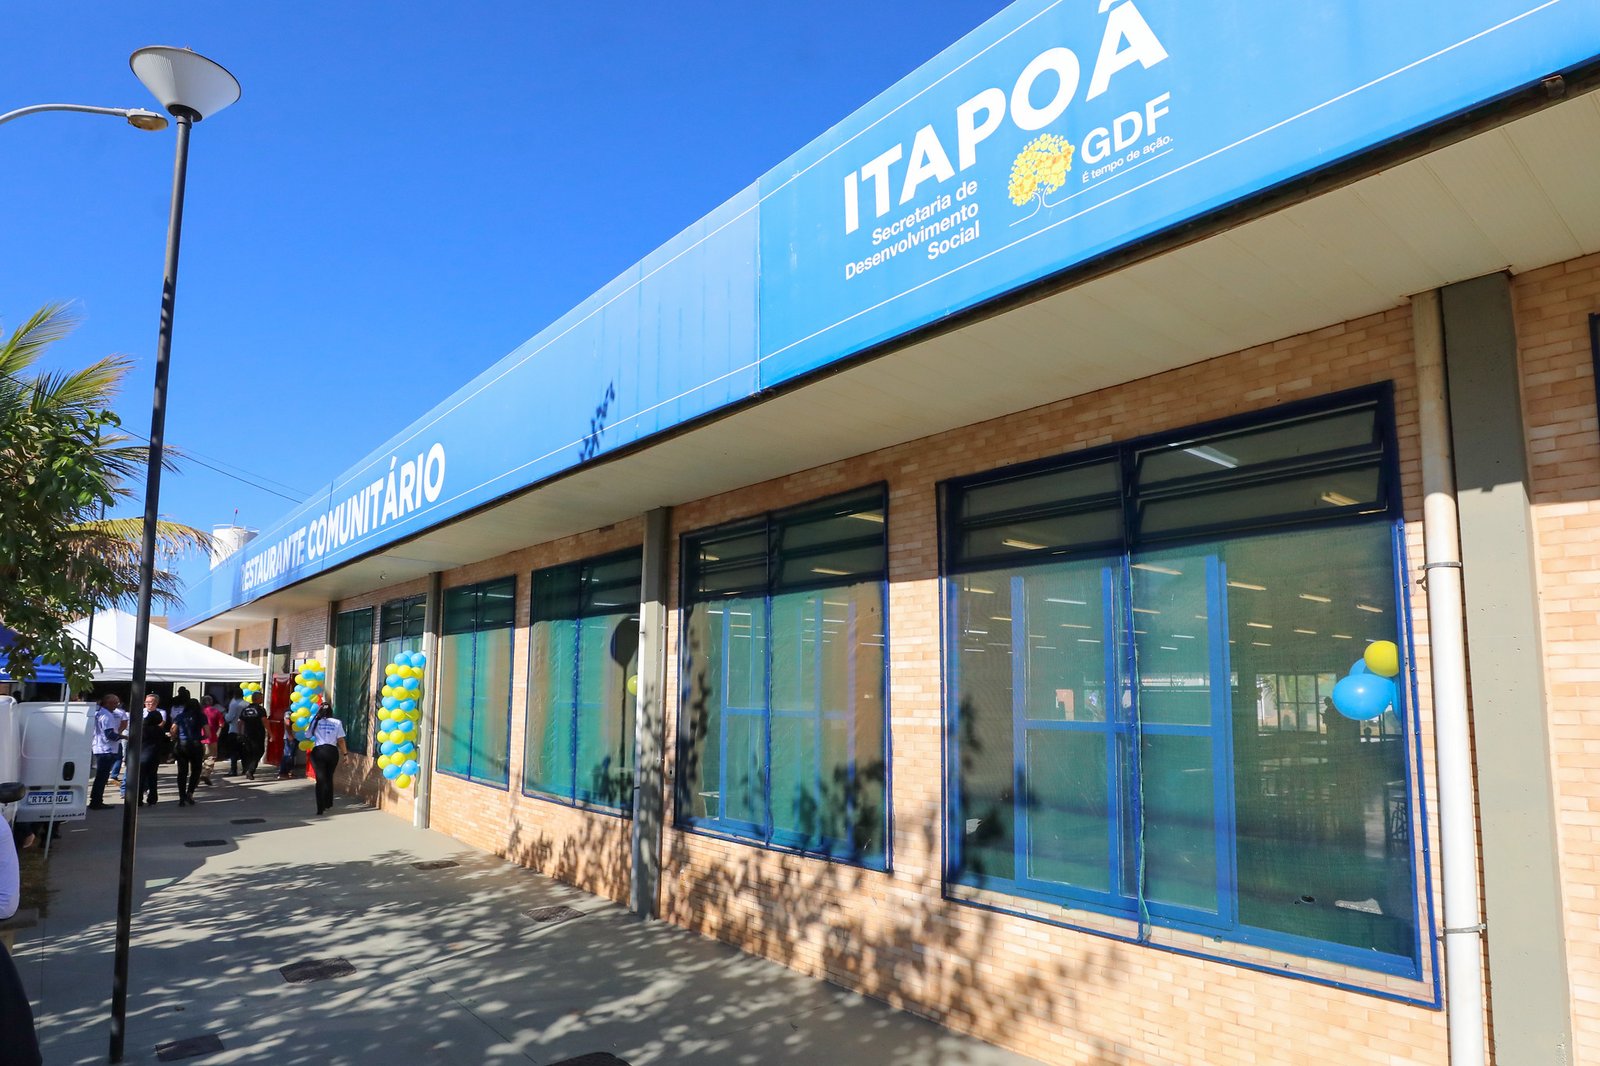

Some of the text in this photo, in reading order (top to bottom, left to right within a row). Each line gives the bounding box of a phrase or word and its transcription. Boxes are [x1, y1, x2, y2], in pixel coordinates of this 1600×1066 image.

[1081, 91, 1171, 164] GDF
[1082, 136, 1174, 184] É tempo de ação.
[845, 203, 979, 281] Desenvolvimento
[872, 180, 978, 246] Secretaria de
[927, 220, 980, 260] Social
[307, 442, 446, 561] COMUNITÁRIO
